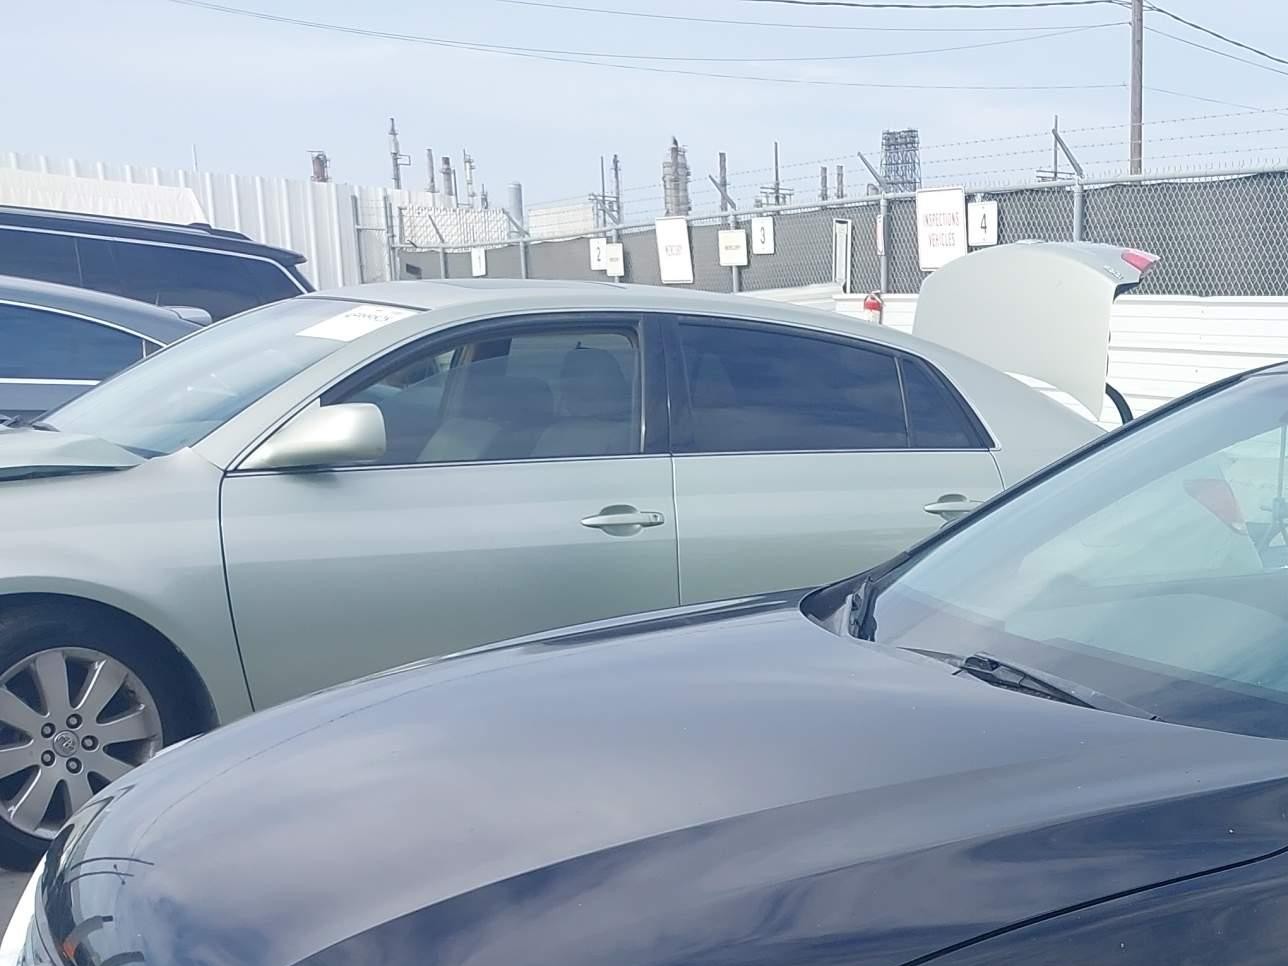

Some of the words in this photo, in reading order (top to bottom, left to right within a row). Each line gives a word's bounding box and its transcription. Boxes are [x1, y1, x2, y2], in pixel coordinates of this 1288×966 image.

[922, 211, 961, 227] INSPECTIONS
[980, 212, 988, 235] 4
[759, 225, 766, 245] 3
[927, 231, 957, 248] VEHICLES
